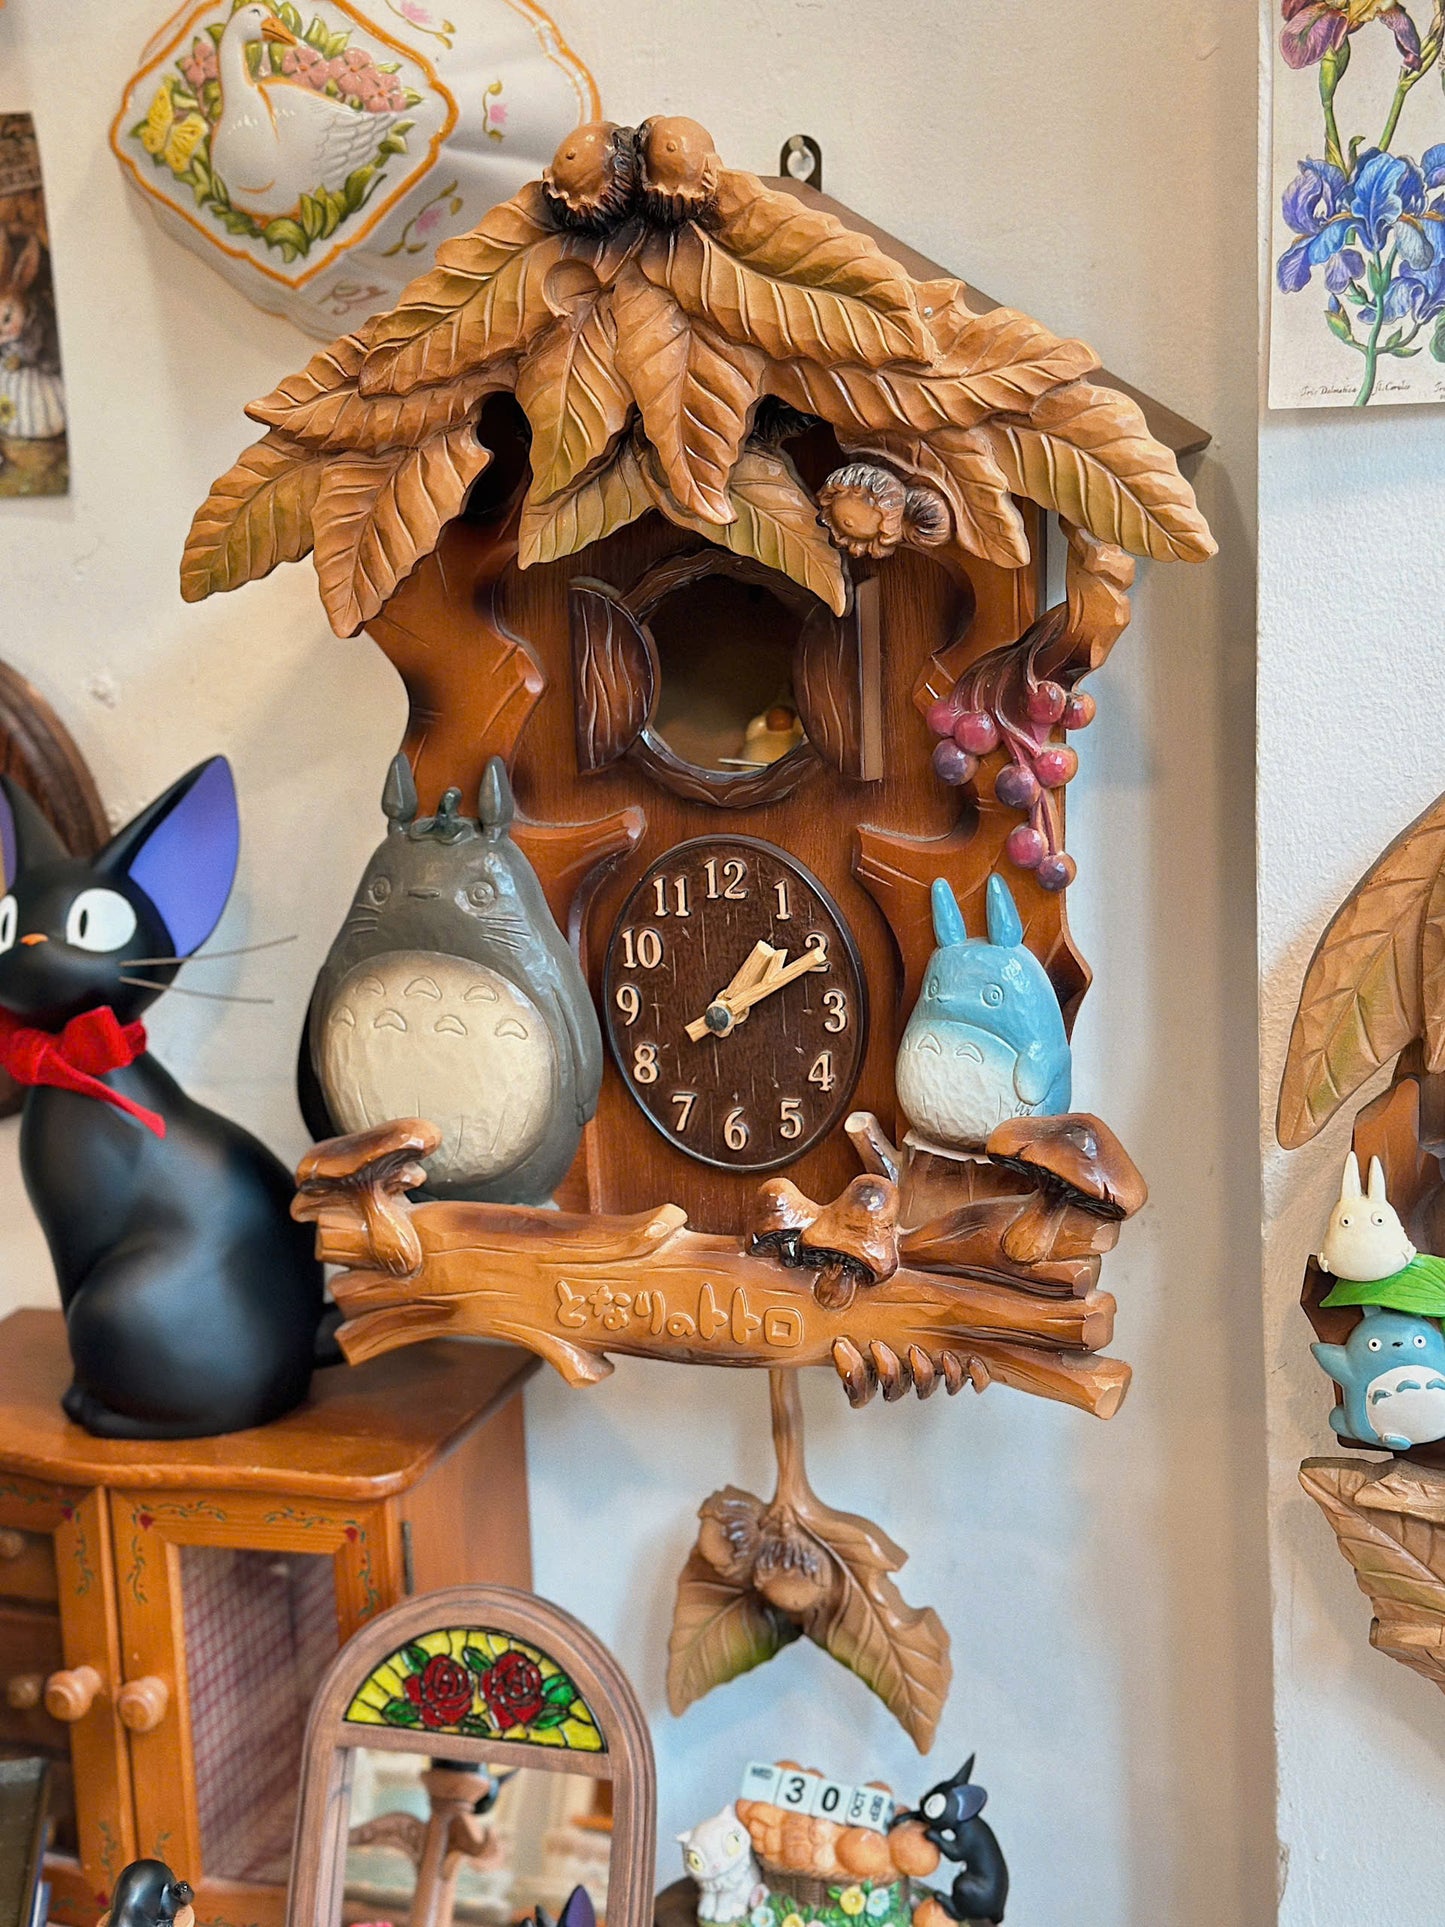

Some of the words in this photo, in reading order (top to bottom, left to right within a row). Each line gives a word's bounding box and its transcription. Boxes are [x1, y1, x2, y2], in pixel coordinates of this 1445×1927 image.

[653, 876, 692, 918] 11
[704, 857, 748, 900] 12
[773, 880, 793, 921] 1
[621, 927, 663, 970] 10
[804, 932, 831, 973] 2
[616, 984, 641, 1027] 9
[823, 989, 847, 1033] 3
[633, 1043, 659, 1084] 8
[807, 1051, 836, 1092] 4
[672, 1092, 697, 1132] 7
[724, 1107, 748, 1151] 6
[780, 1098, 804, 1139] 5
[556, 1279, 804, 1348] となりのトトロ
[851, 1790, 866, 1818] OCT
